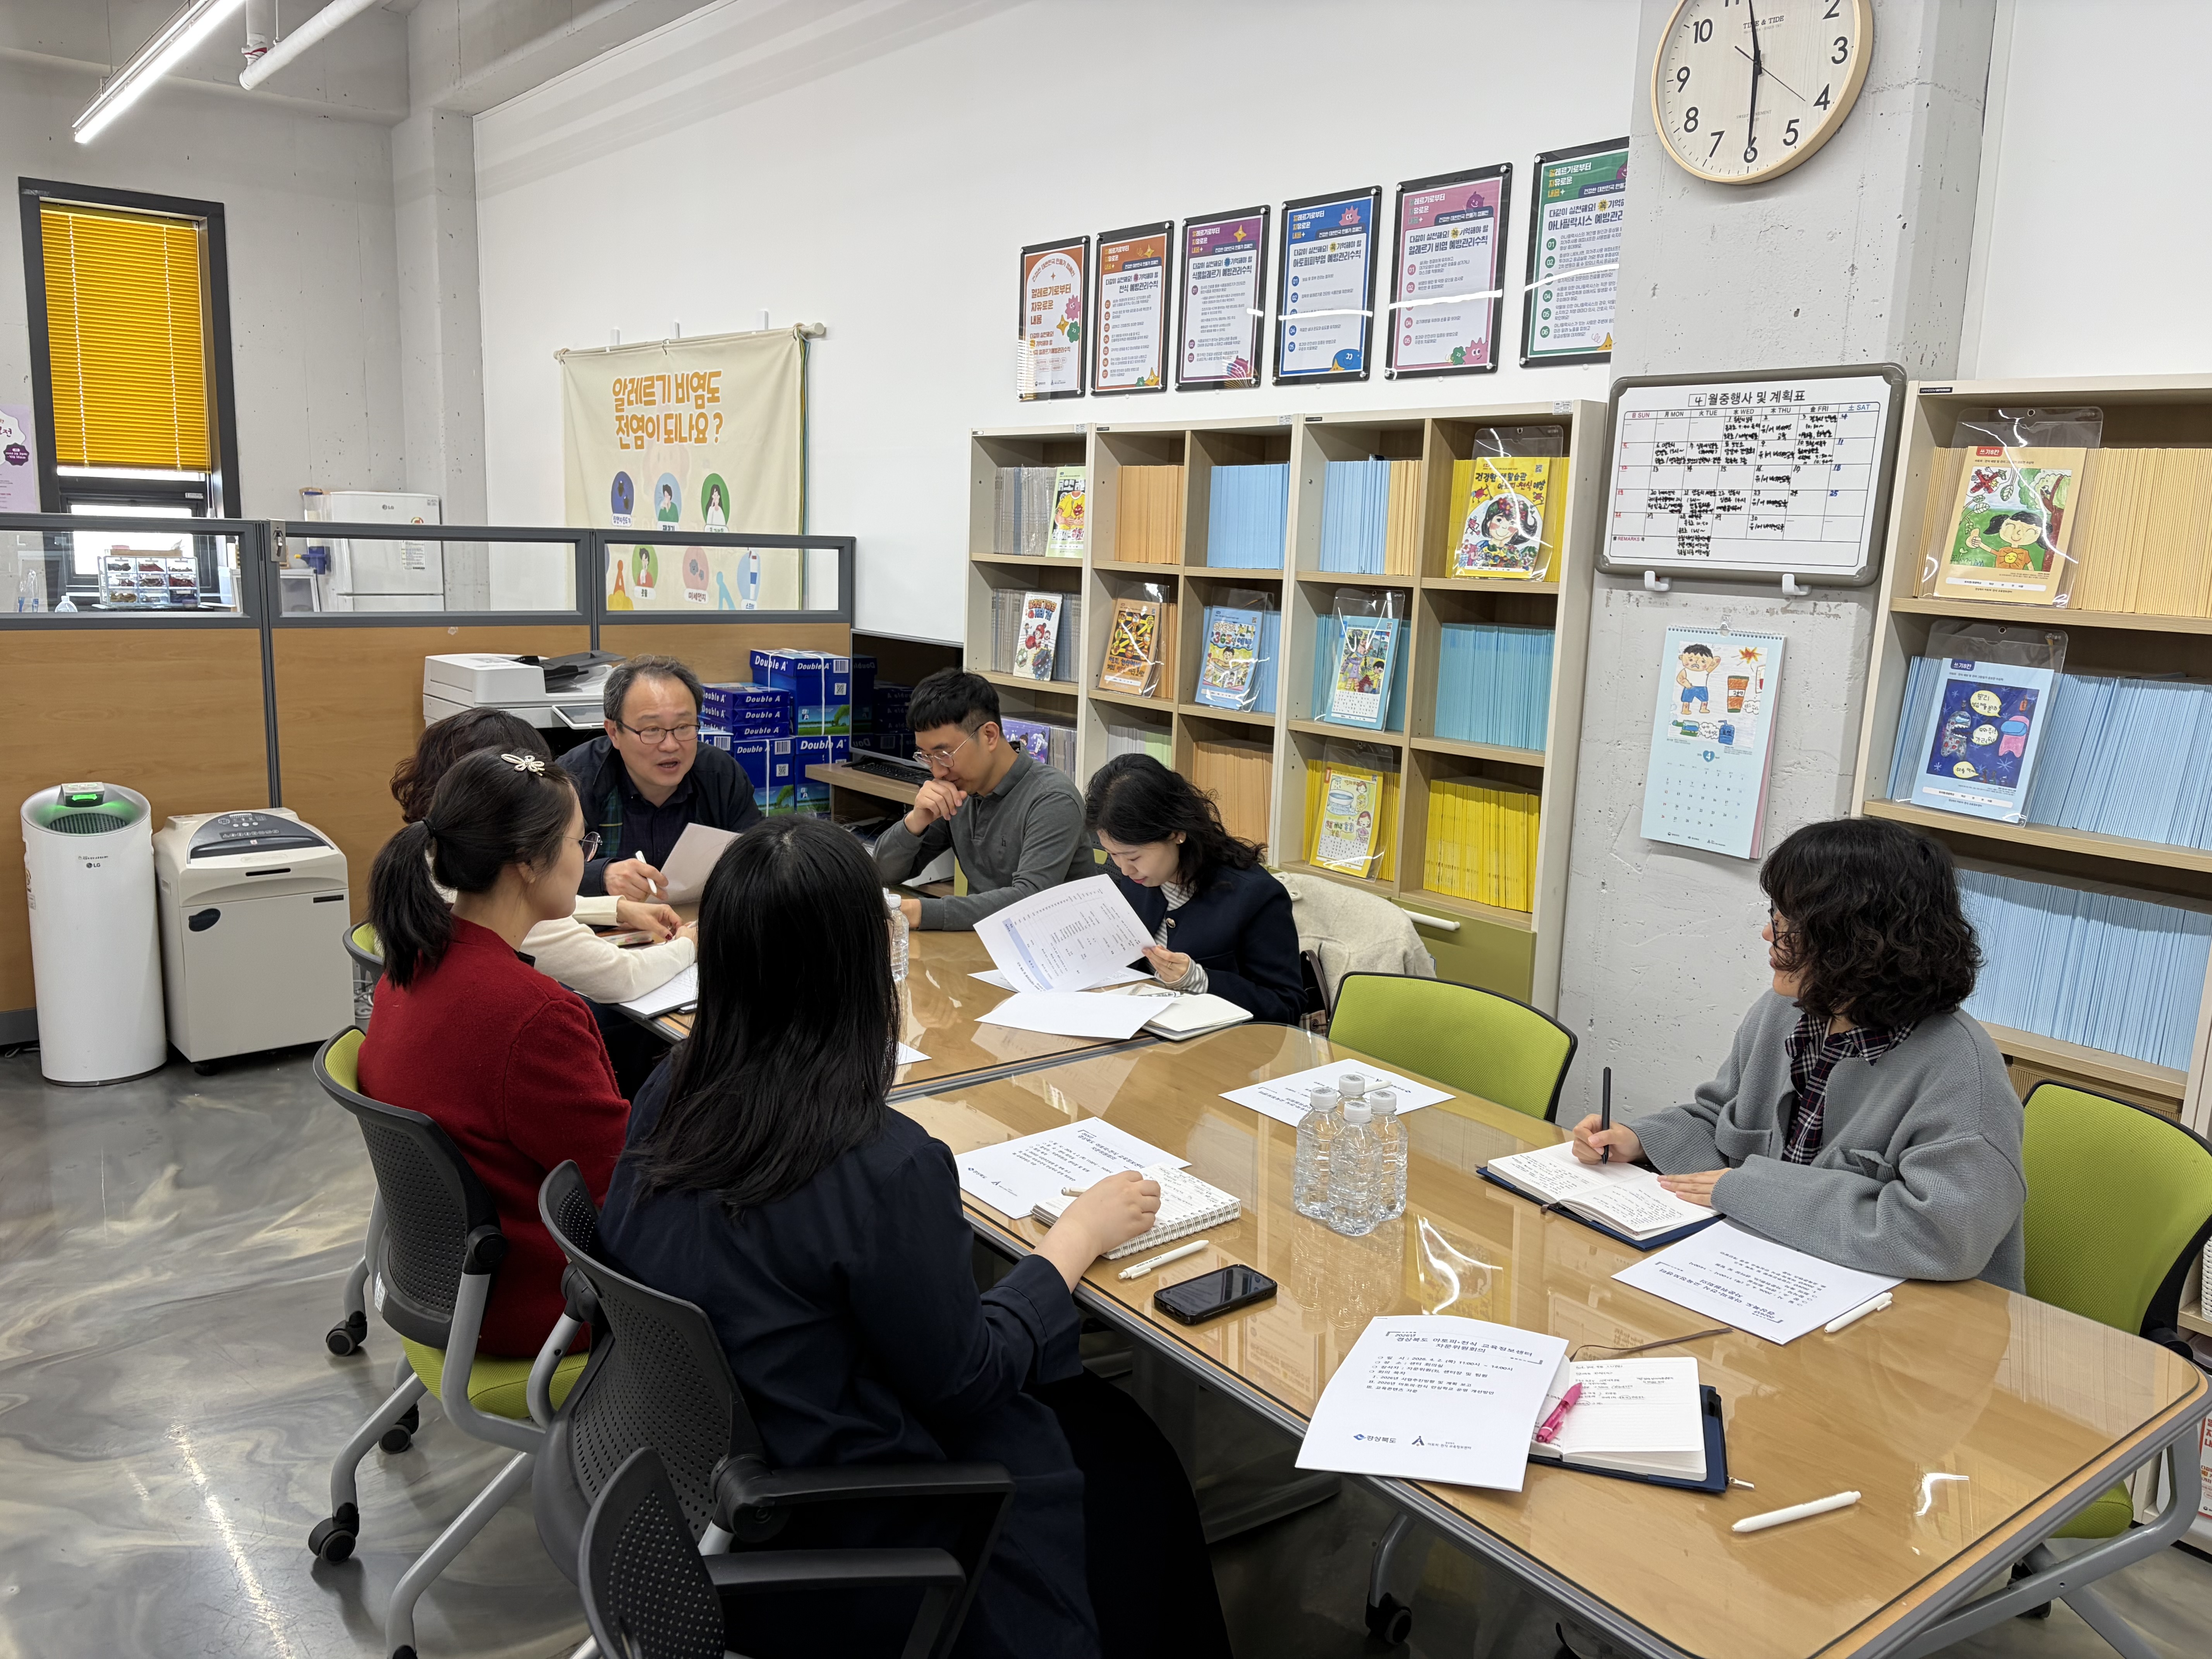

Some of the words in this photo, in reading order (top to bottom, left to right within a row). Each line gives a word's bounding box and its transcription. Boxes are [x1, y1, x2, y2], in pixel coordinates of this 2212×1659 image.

[1822, 0, 1840, 19] 2
[1769, 15, 1784, 24] TIDE
[1693, 19, 1712, 43] 10
[1831, 36, 1848, 64] 3
[1676, 66, 1690, 93] 9
[1813, 84, 1830, 110] 4
[1683, 107, 1698, 133] 8
[1783, 118, 1799, 146] 5
[1711, 131, 1725, 158] 7
[1743, 136, 1758, 163] 6
[1549, 162, 1591, 177] 알레르기로부터
[1549, 177, 1572, 187] 자유로운
[1409, 194, 1445, 206] 알레르기로부터
[1548, 189, 1559, 198] 내몸
[1293, 210, 1324, 222] 알레르기로부터
[1409, 206, 1429, 215] 자유로운
[1549, 208, 1567, 218] 다같이
[1569, 203, 1596, 215] 실천해요!
[1293, 222, 1310, 230] 자유로운
[1548, 215, 1592, 231] 아나필락시스
[1410, 234, 1425, 243] 다같이
[1426, 230, 1449, 240] 실천해요!
[1460, 227, 1481, 236] 기억해야
[1309, 245, 1328, 254] 실천해요!
[1408, 245, 1432, 255] 알레르기
[1435, 241, 1447, 251] 비염
[1449, 235, 1487, 249] 예방관리수칙
[1293, 255, 1326, 267] 아토피피부염
[1328, 250, 1361, 263] 예방관리수칙
[1192, 269, 1221, 280] 식품알레르기
[1223, 266, 1252, 276] 예방관리수칙
[1032, 283, 1071, 299] 알레르기로부터
[1119, 285, 1128, 293] 천식
[1130, 280, 1158, 292] 예방관리수칙
[1031, 300, 1053, 312] 자유로운
[1030, 315, 1042, 325] 내몸
[612, 374, 672, 413] 알레르기
[674, 370, 722, 409] 비염도
[1708, 392, 1752, 405] 월중행사
[1757, 391, 1766, 403] 및
[1770, 390, 1805, 402] 계획표
[1695, 397, 1703, 406] 4
[615, 414, 660, 450] 전염이
[1475, 473, 1497, 482] 건강한
[689, 592, 706, 601] 미세먼지
[755, 656, 779, 669] Double
[781, 661, 788, 671] A
[721, 695, 726, 703] A
[702, 705, 720, 716] Double
[721, 710, 725, 718] A
[800, 740, 833, 750] Double
[836, 739, 846, 749] A
[1436, 1343, 1486, 1353] 자문위원회의
[1481, 1344, 1533, 1357] 교육정보센터
[1367, 1435, 1396, 1444] 경상북도
